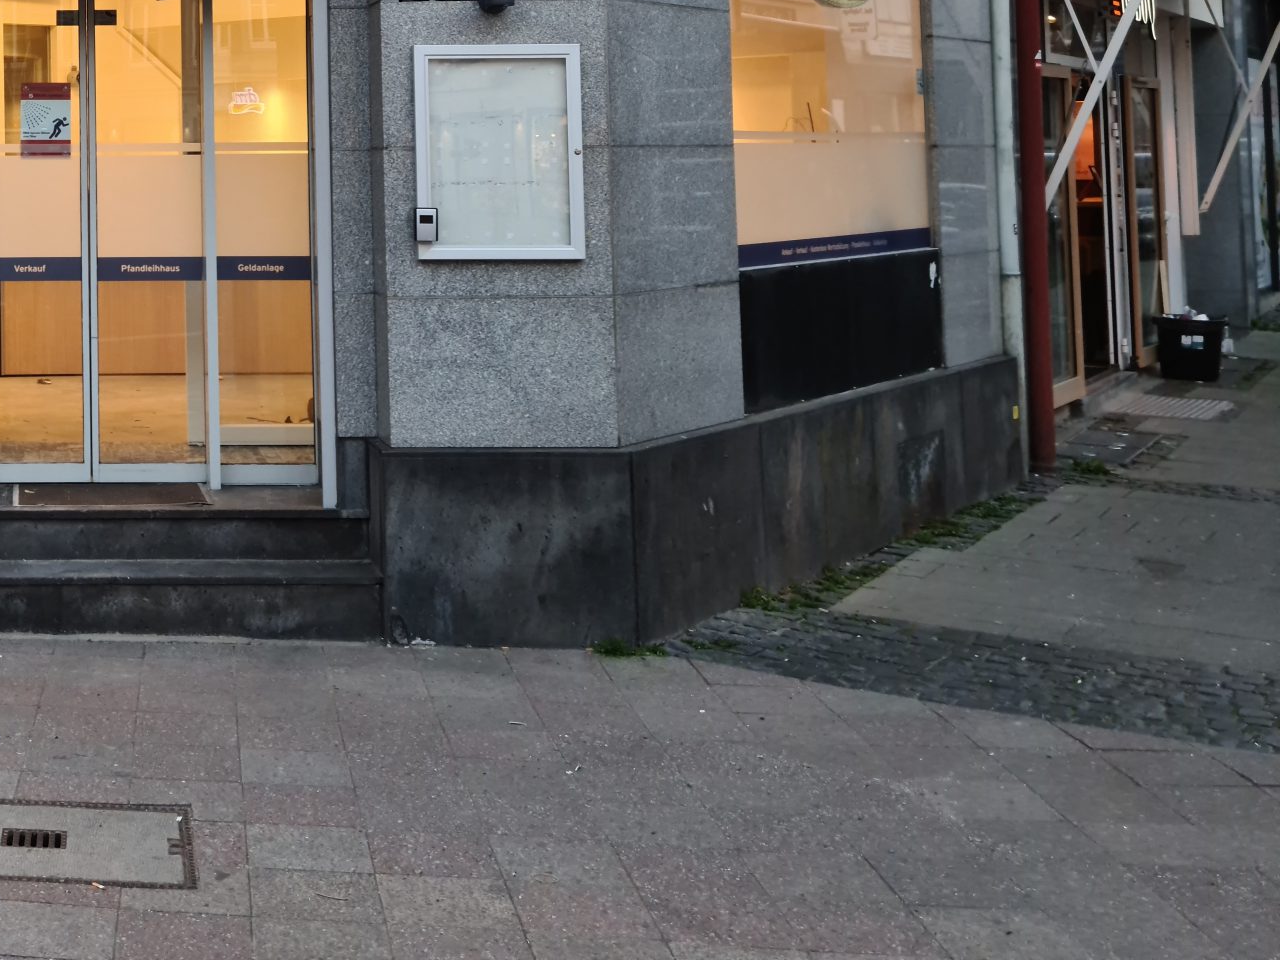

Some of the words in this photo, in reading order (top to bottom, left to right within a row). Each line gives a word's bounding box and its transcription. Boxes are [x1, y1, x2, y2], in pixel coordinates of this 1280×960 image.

[13, 264, 46, 273] Verkauf
[121, 264, 180, 273] Pfandleihhaus
[237, 263, 285, 273] Geldanlage
